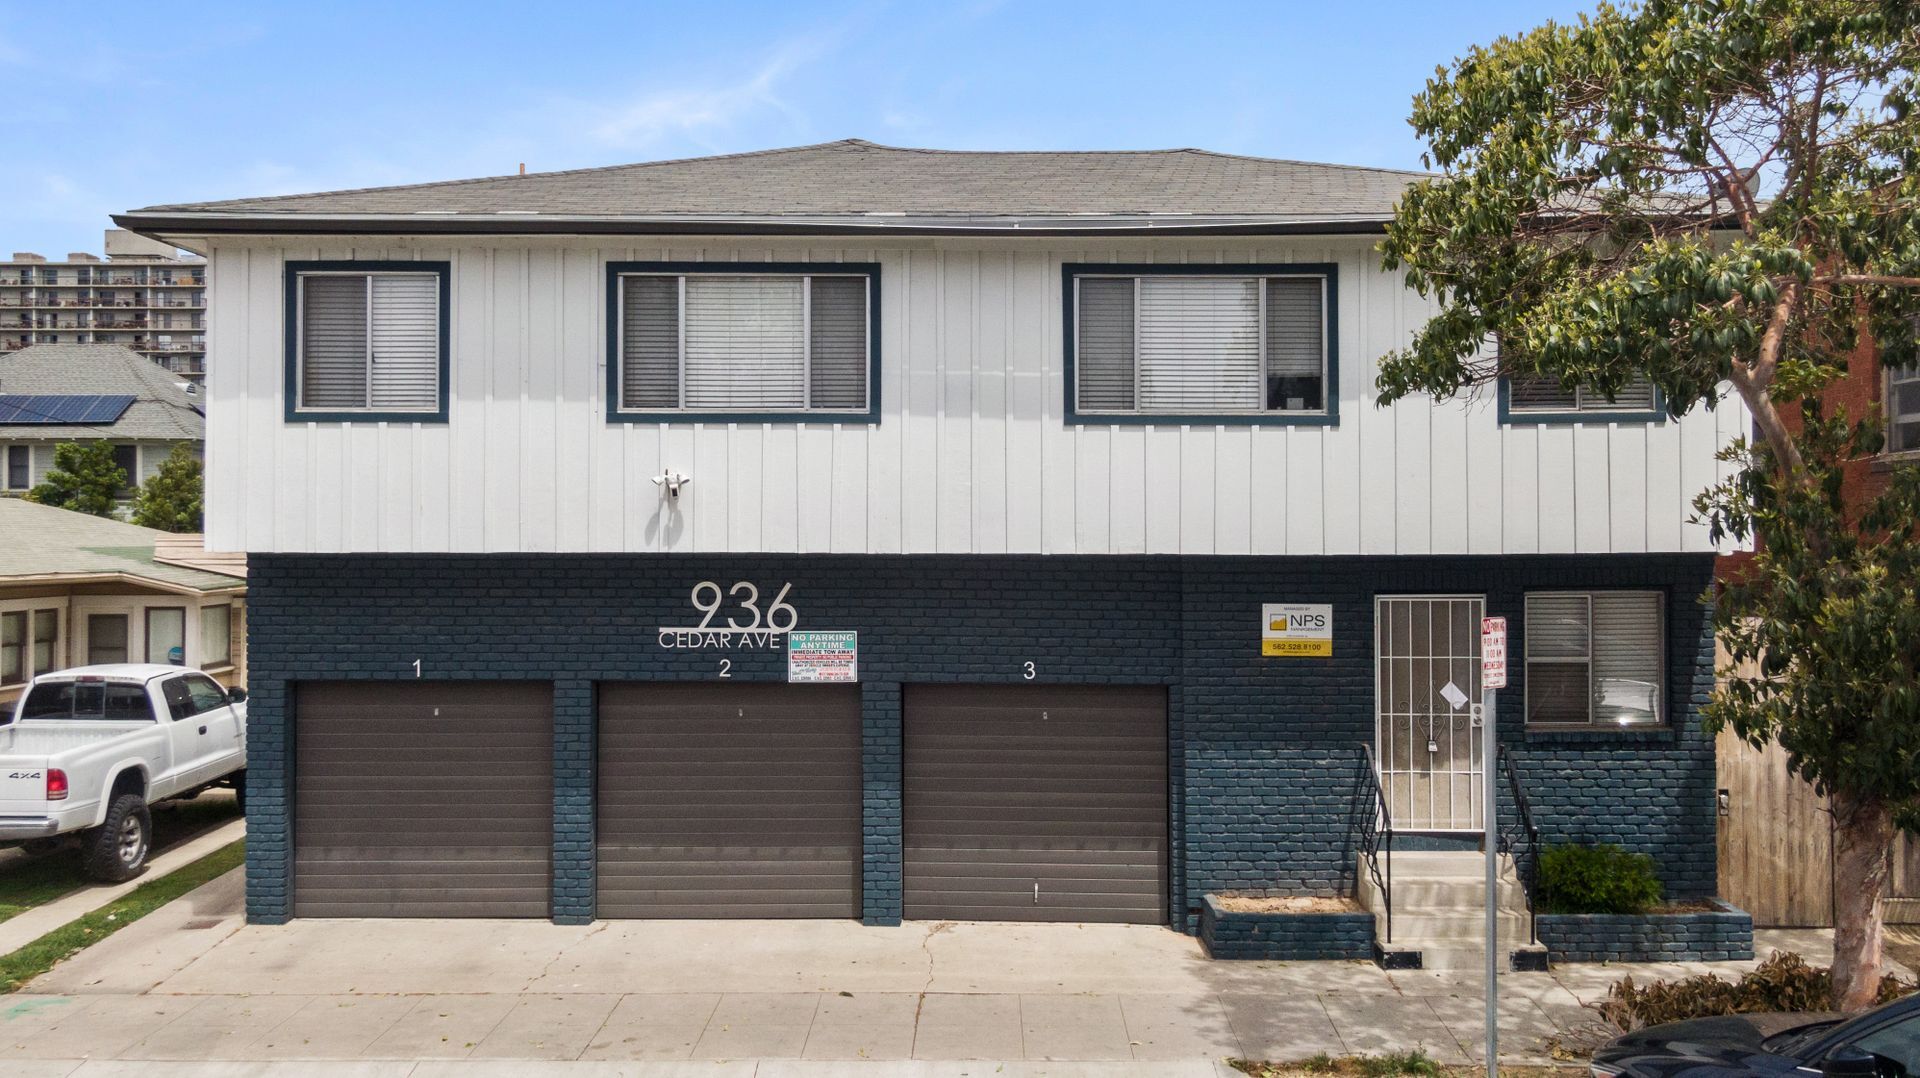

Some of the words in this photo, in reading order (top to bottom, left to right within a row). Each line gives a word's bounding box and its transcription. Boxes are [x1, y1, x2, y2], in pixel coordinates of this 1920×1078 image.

[691, 581, 798, 633] 936
[1290, 614, 1325, 627] NPS
[1483, 620, 1490, 633] NO
[1491, 621, 1505, 632] PARKING
[659, 631, 731, 648] CEDAR
[738, 631, 780, 648] AVE
[800, 641, 846, 649] ANYTIME
[412, 658, 421, 678] 1
[719, 658, 732, 678] 2
[1023, 661, 1036, 680] 3
